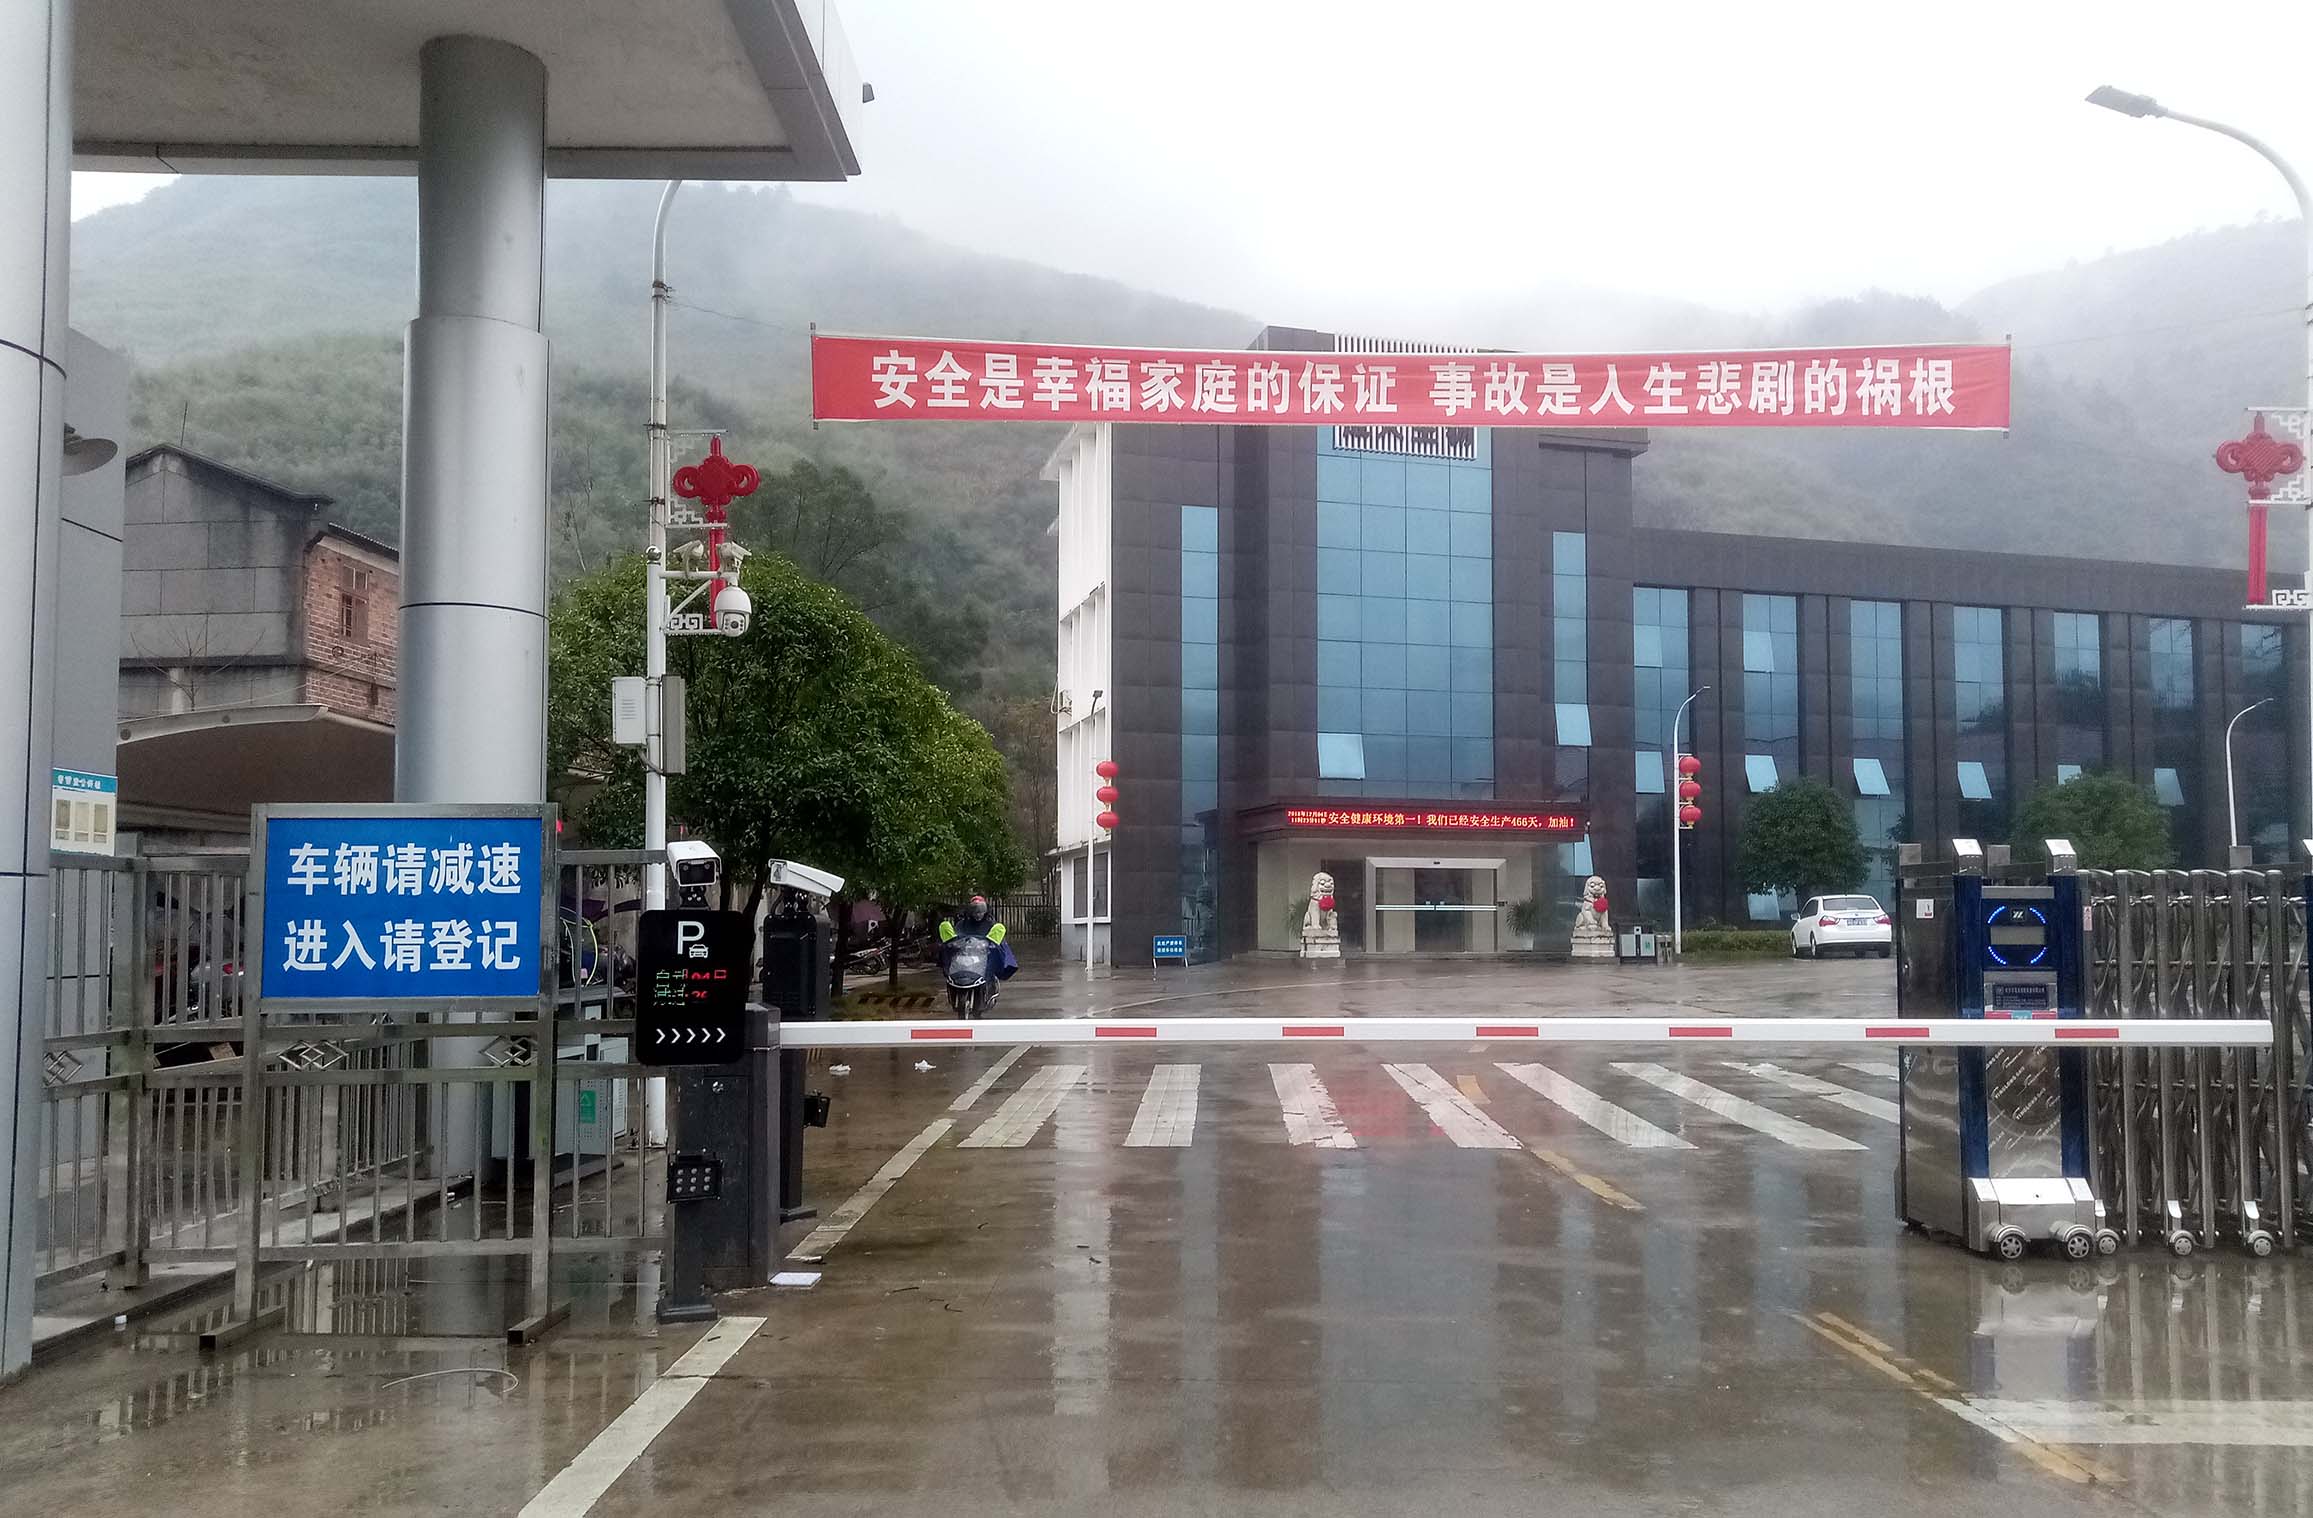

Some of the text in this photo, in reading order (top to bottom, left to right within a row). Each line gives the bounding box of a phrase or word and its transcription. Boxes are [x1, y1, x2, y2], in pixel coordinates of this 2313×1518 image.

[871, 349, 1955, 416] 安全是幸福家庭的保证 事故是人生悲剧的祸根
[287, 842, 521, 896] 车辆请减速
[283, 919, 521, 972] 进入请登记
[677, 920, 705, 955] P
